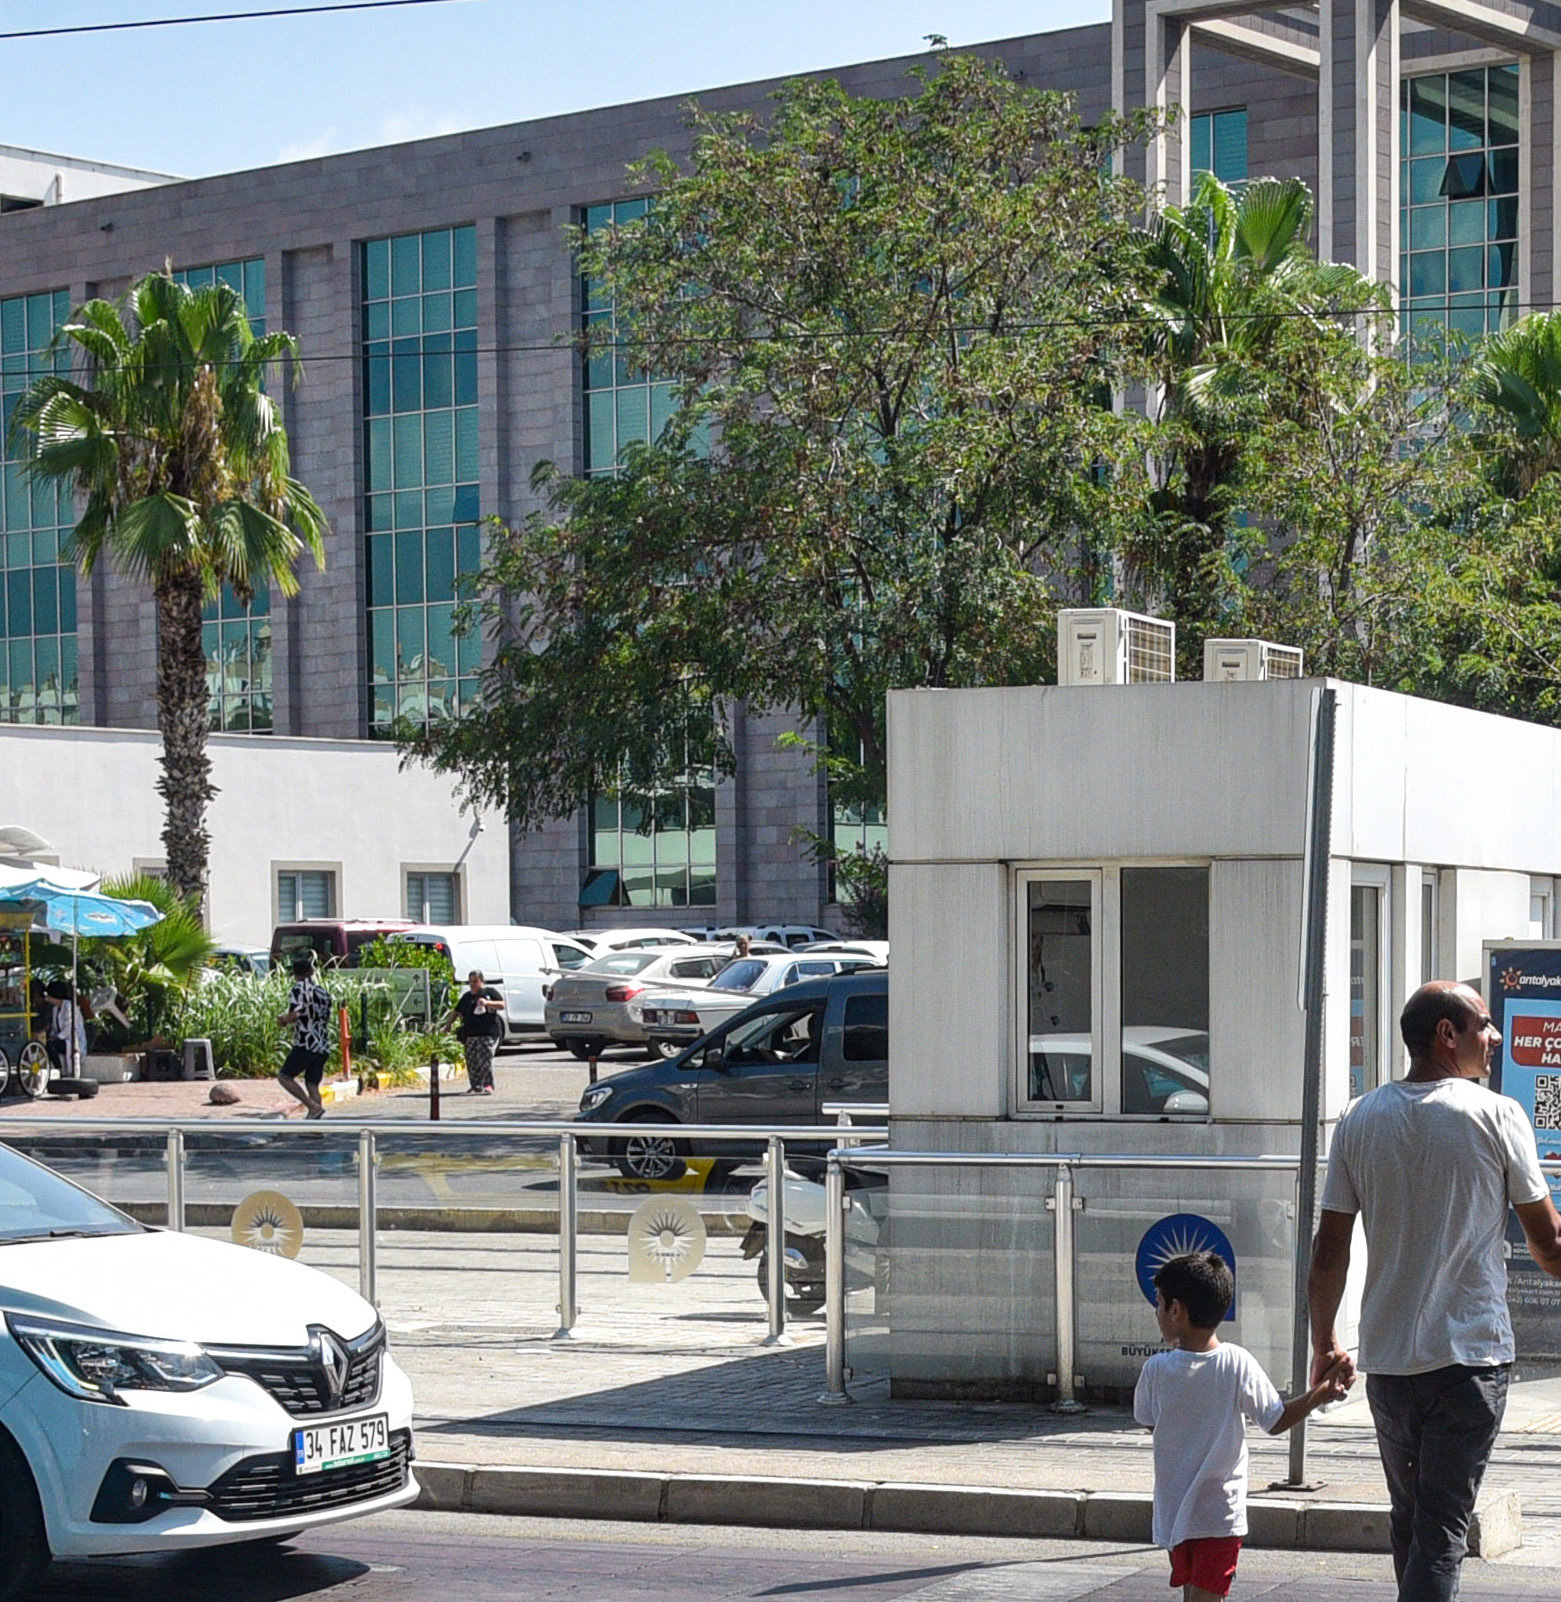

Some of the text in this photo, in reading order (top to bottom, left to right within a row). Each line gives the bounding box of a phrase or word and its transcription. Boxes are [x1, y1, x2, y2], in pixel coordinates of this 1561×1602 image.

[1513, 1036, 1542, 1048] HER
[1121, 1344, 1173, 1357] BÜYÜK
[305, 1420, 385, 1460] 34 FAZ 579
